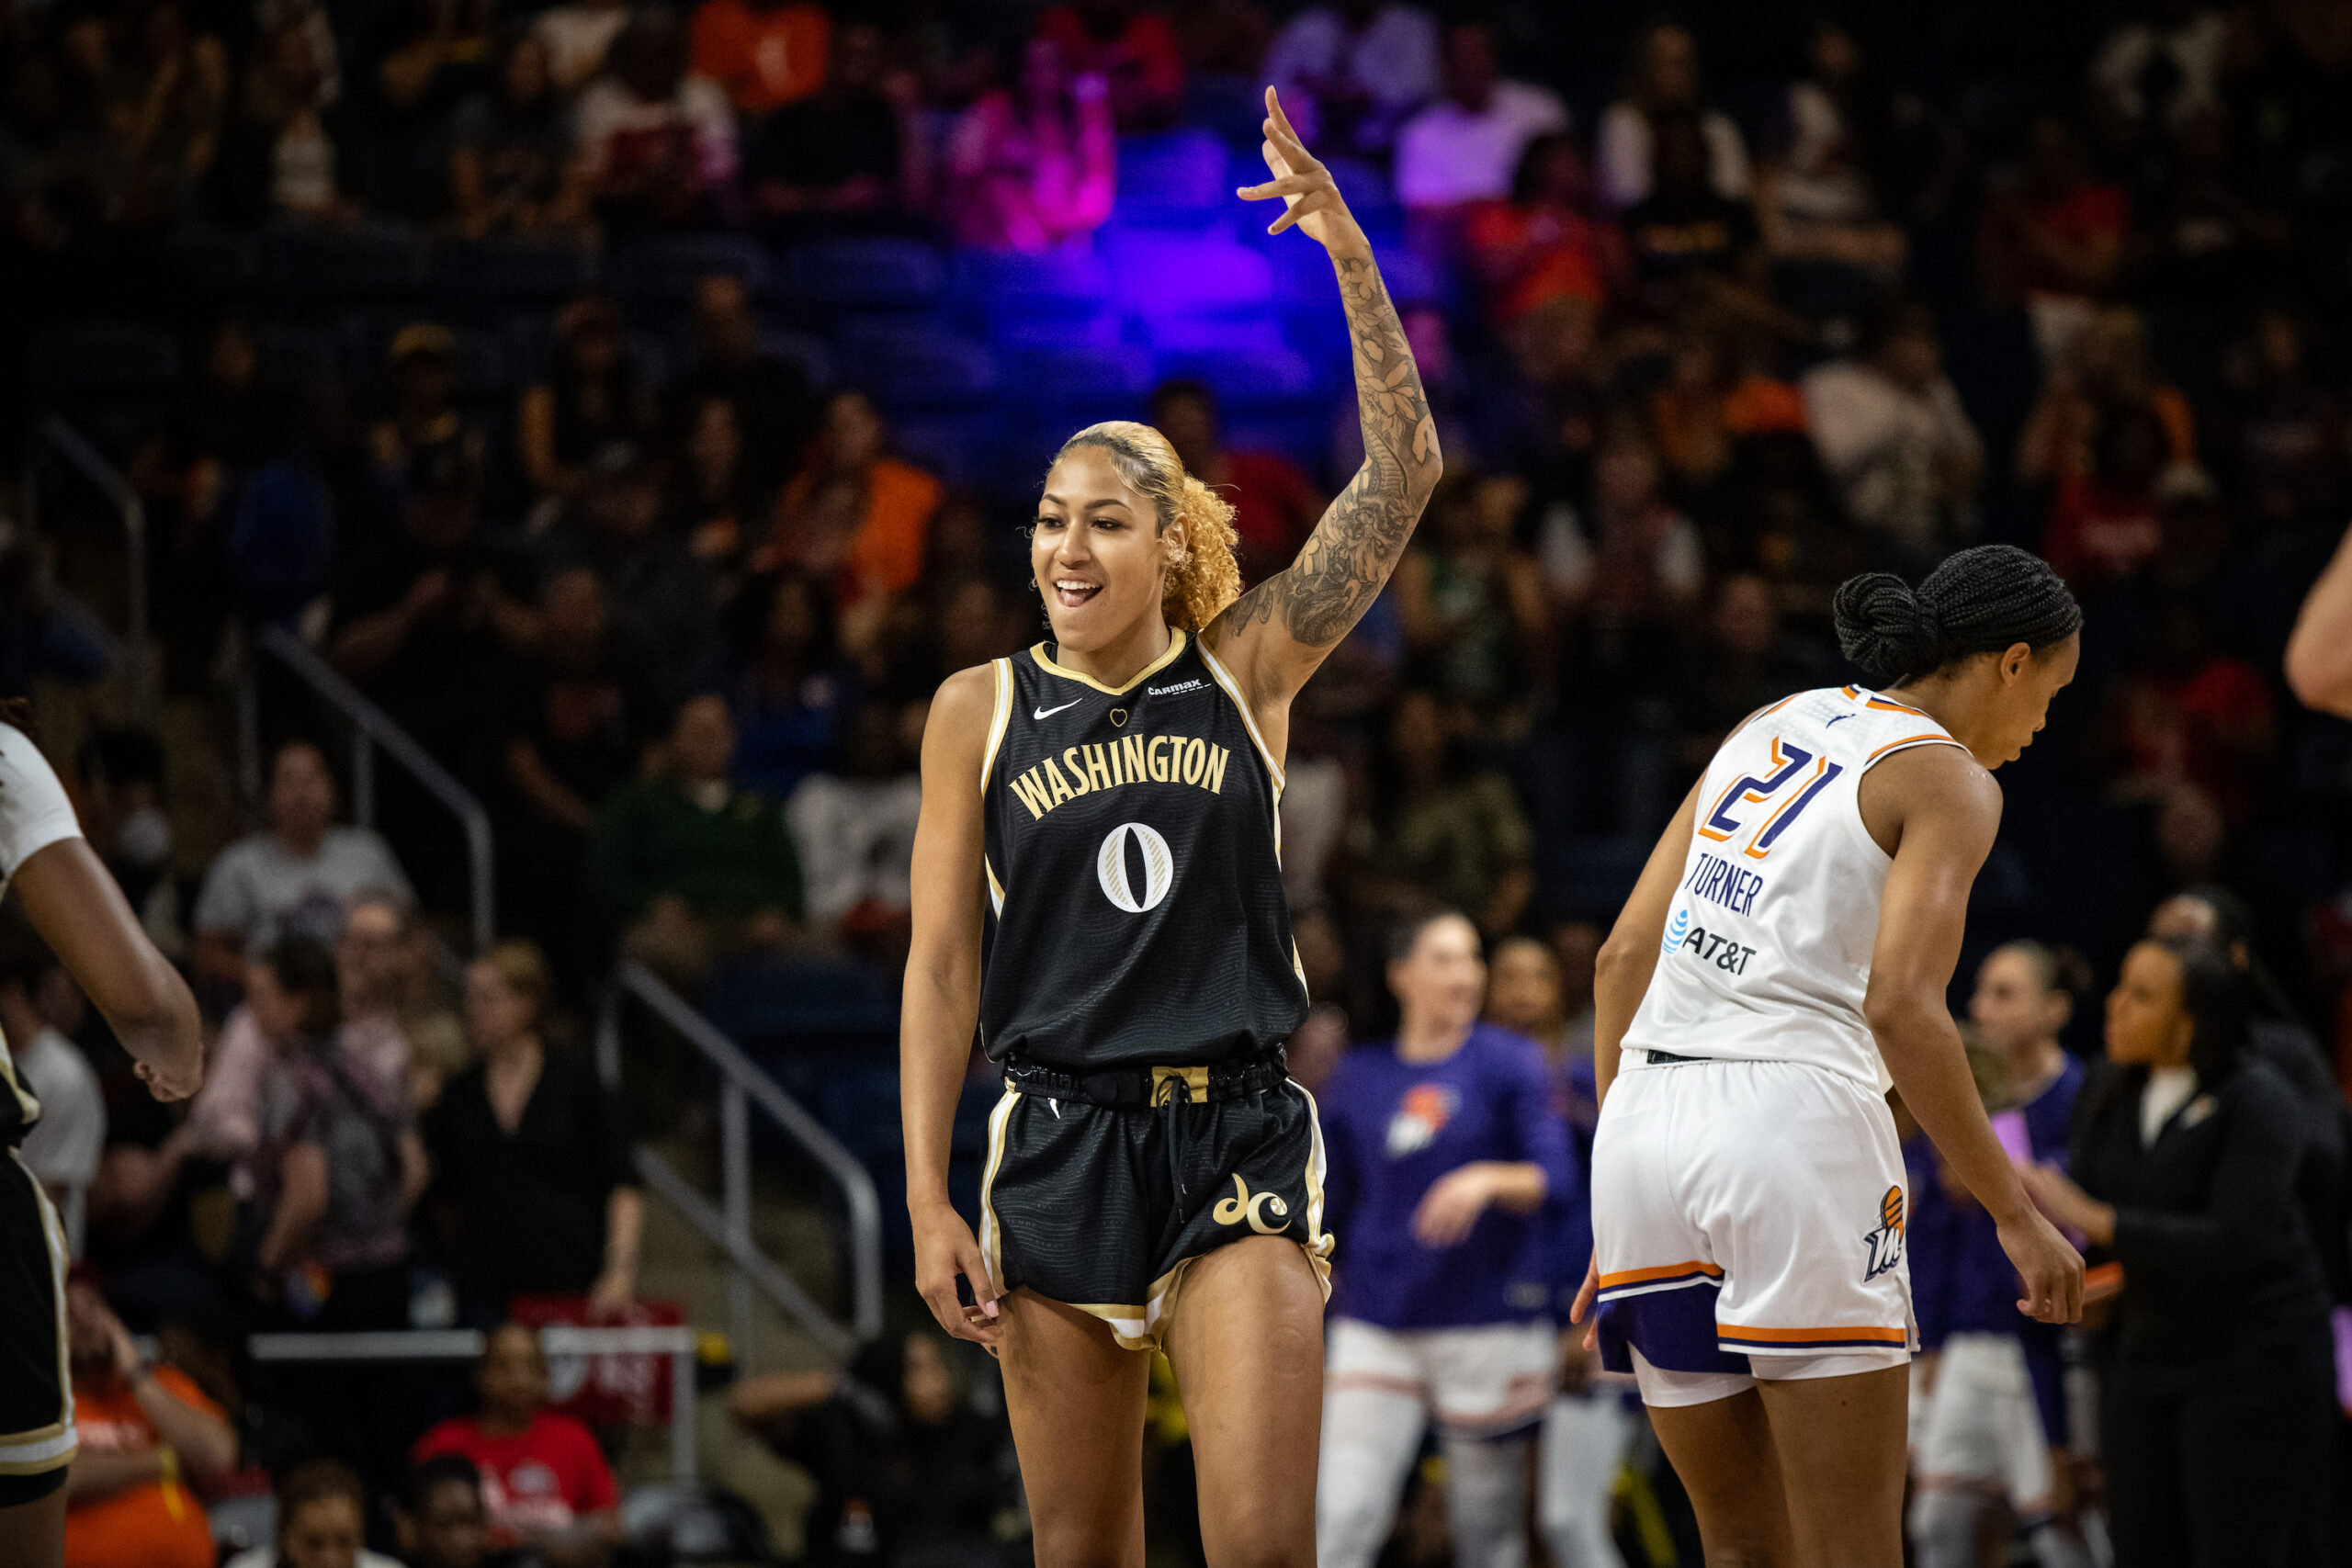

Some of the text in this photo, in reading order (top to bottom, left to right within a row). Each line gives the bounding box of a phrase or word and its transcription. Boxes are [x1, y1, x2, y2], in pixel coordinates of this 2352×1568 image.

[1009, 734, 1231, 821] WASHINGTON
[1698, 735, 1844, 859] 21
[1098, 822, 1173, 912] 0
[1684, 852, 1764, 917] TURNER
[1682, 927, 1757, 976] AT&T
